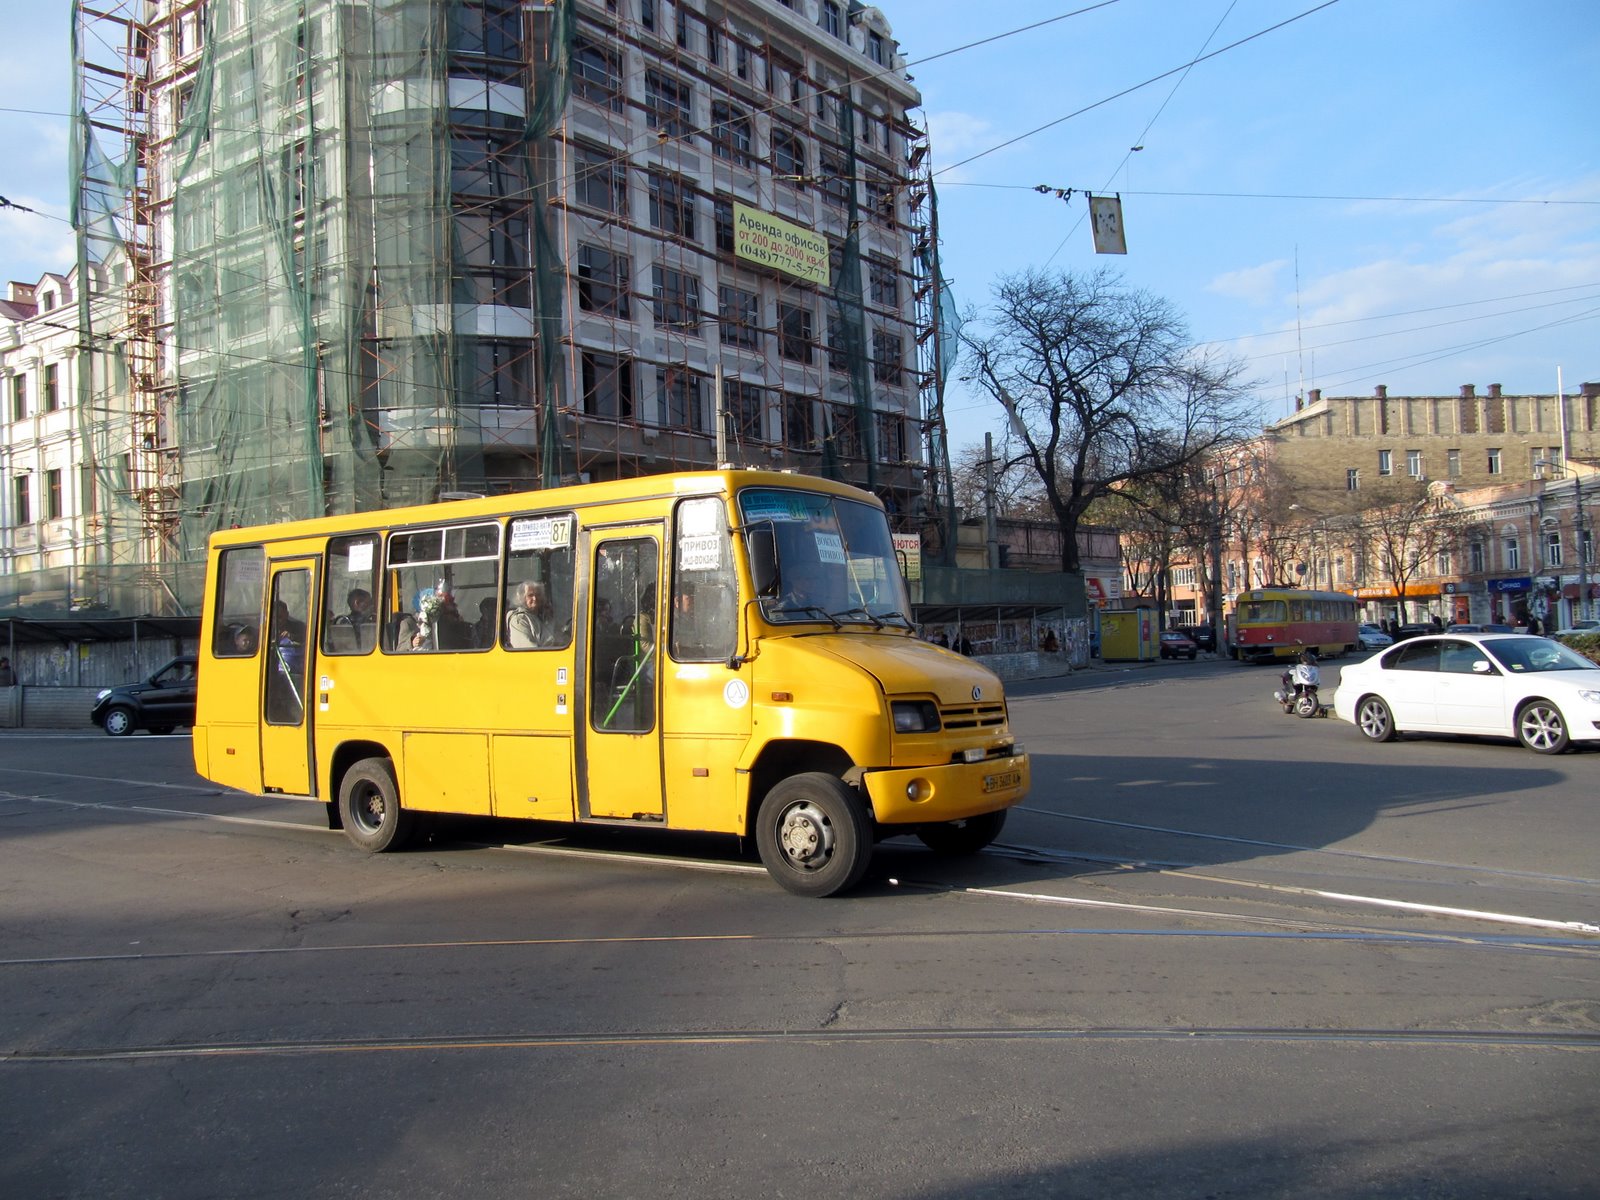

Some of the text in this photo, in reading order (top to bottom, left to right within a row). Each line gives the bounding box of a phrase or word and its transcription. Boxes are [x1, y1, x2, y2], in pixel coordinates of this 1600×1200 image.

[739, 213, 825, 255] Аренда офисов
[739, 230, 750, 240] от
[752, 232, 768, 247] 200
[770, 241, 783, 253] до
[784, 244, 804, 261] 2000
[740, 243, 826, 280] (048)777-5-777
[684, 539, 718, 552] ПРИВОЗ
